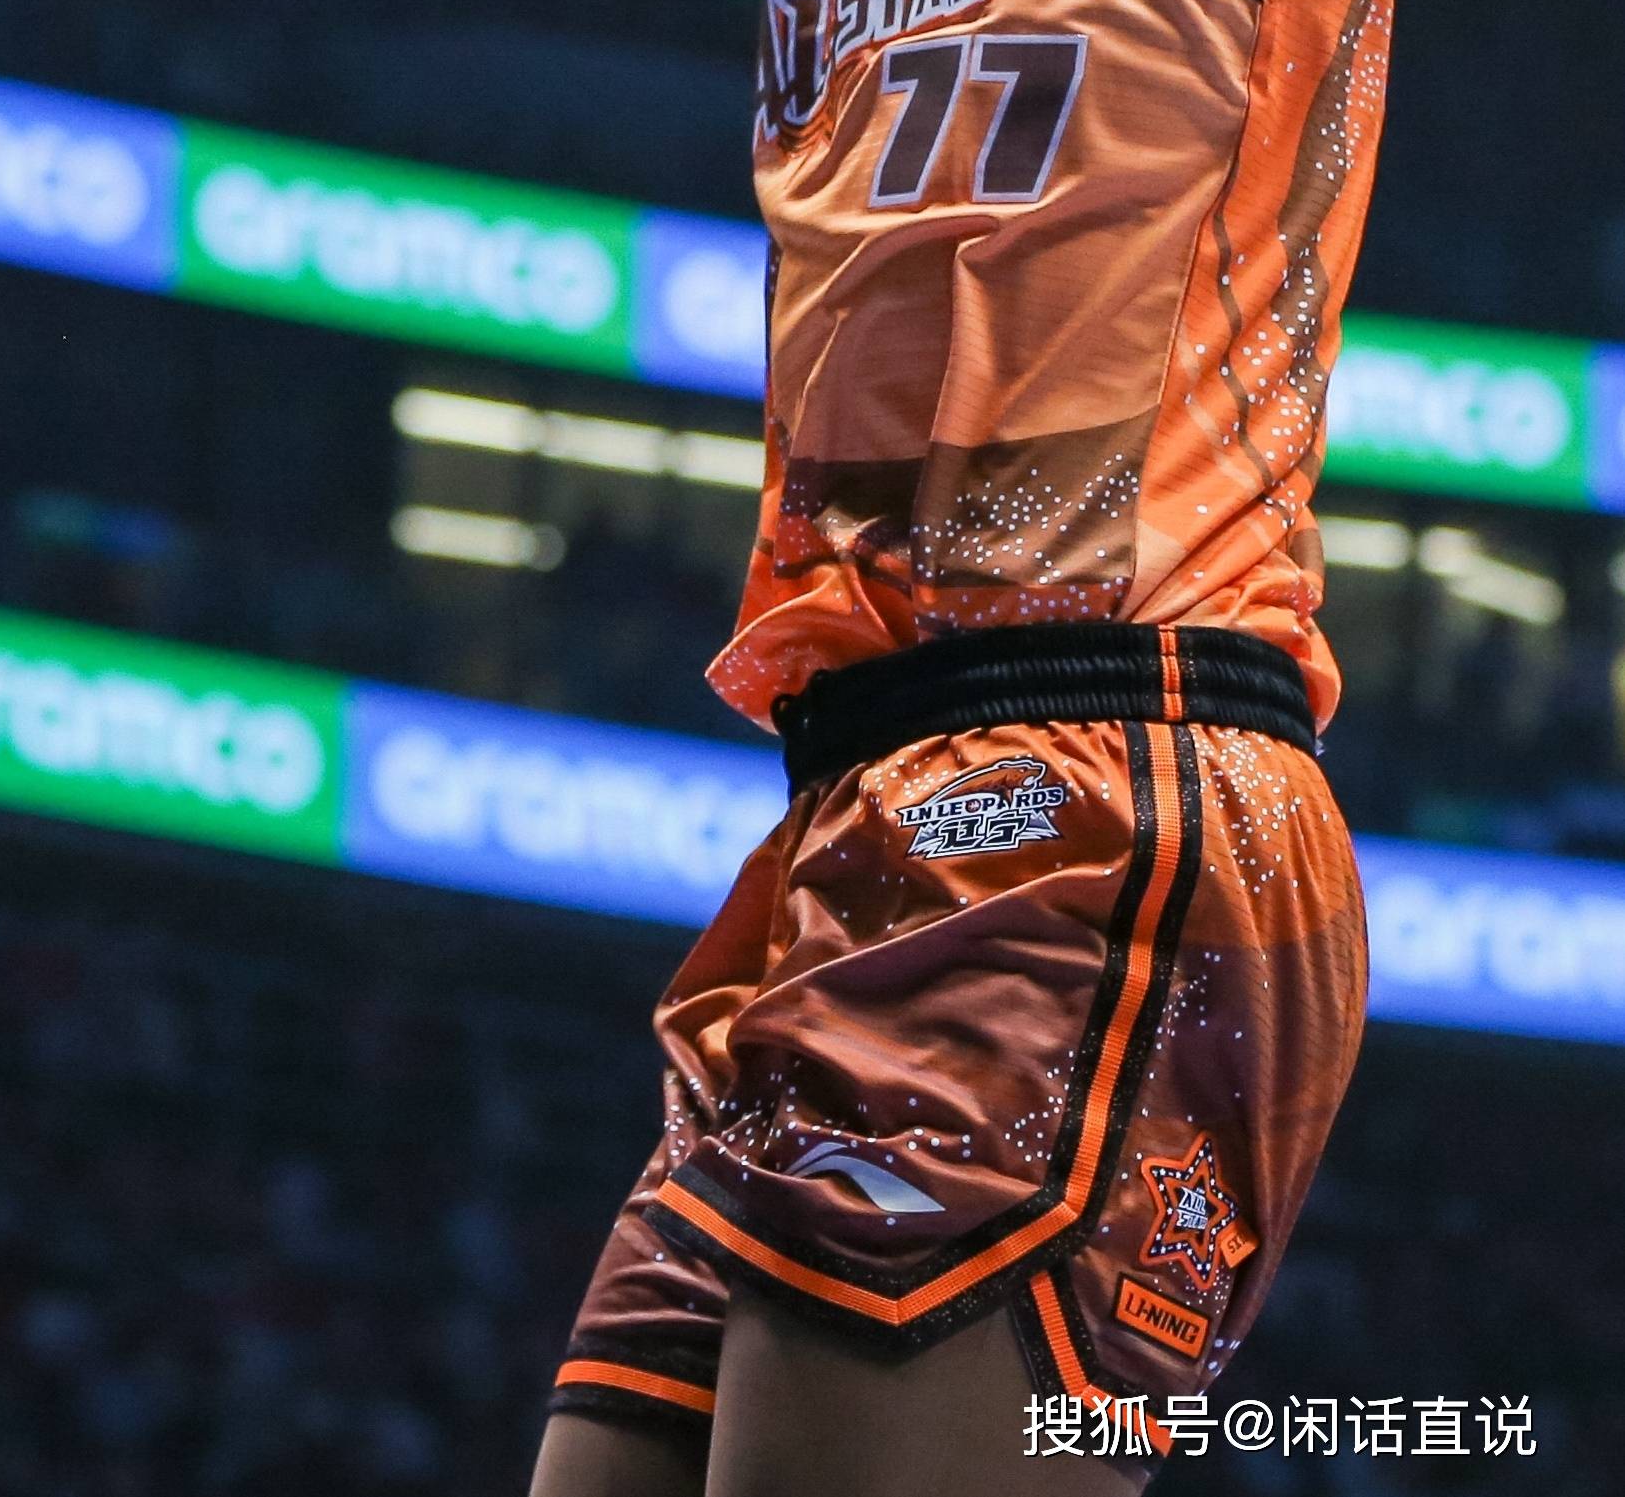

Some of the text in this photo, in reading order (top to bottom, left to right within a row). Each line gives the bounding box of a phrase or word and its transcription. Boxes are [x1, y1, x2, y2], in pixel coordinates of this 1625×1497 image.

[869, 34, 1088, 209] 77
[199, 172, 615, 332] aramco
[905, 806, 933, 824] LN
[1178, 1186, 1207, 1215] ALL
[1124, 1292, 1201, 1345] LI-NING
